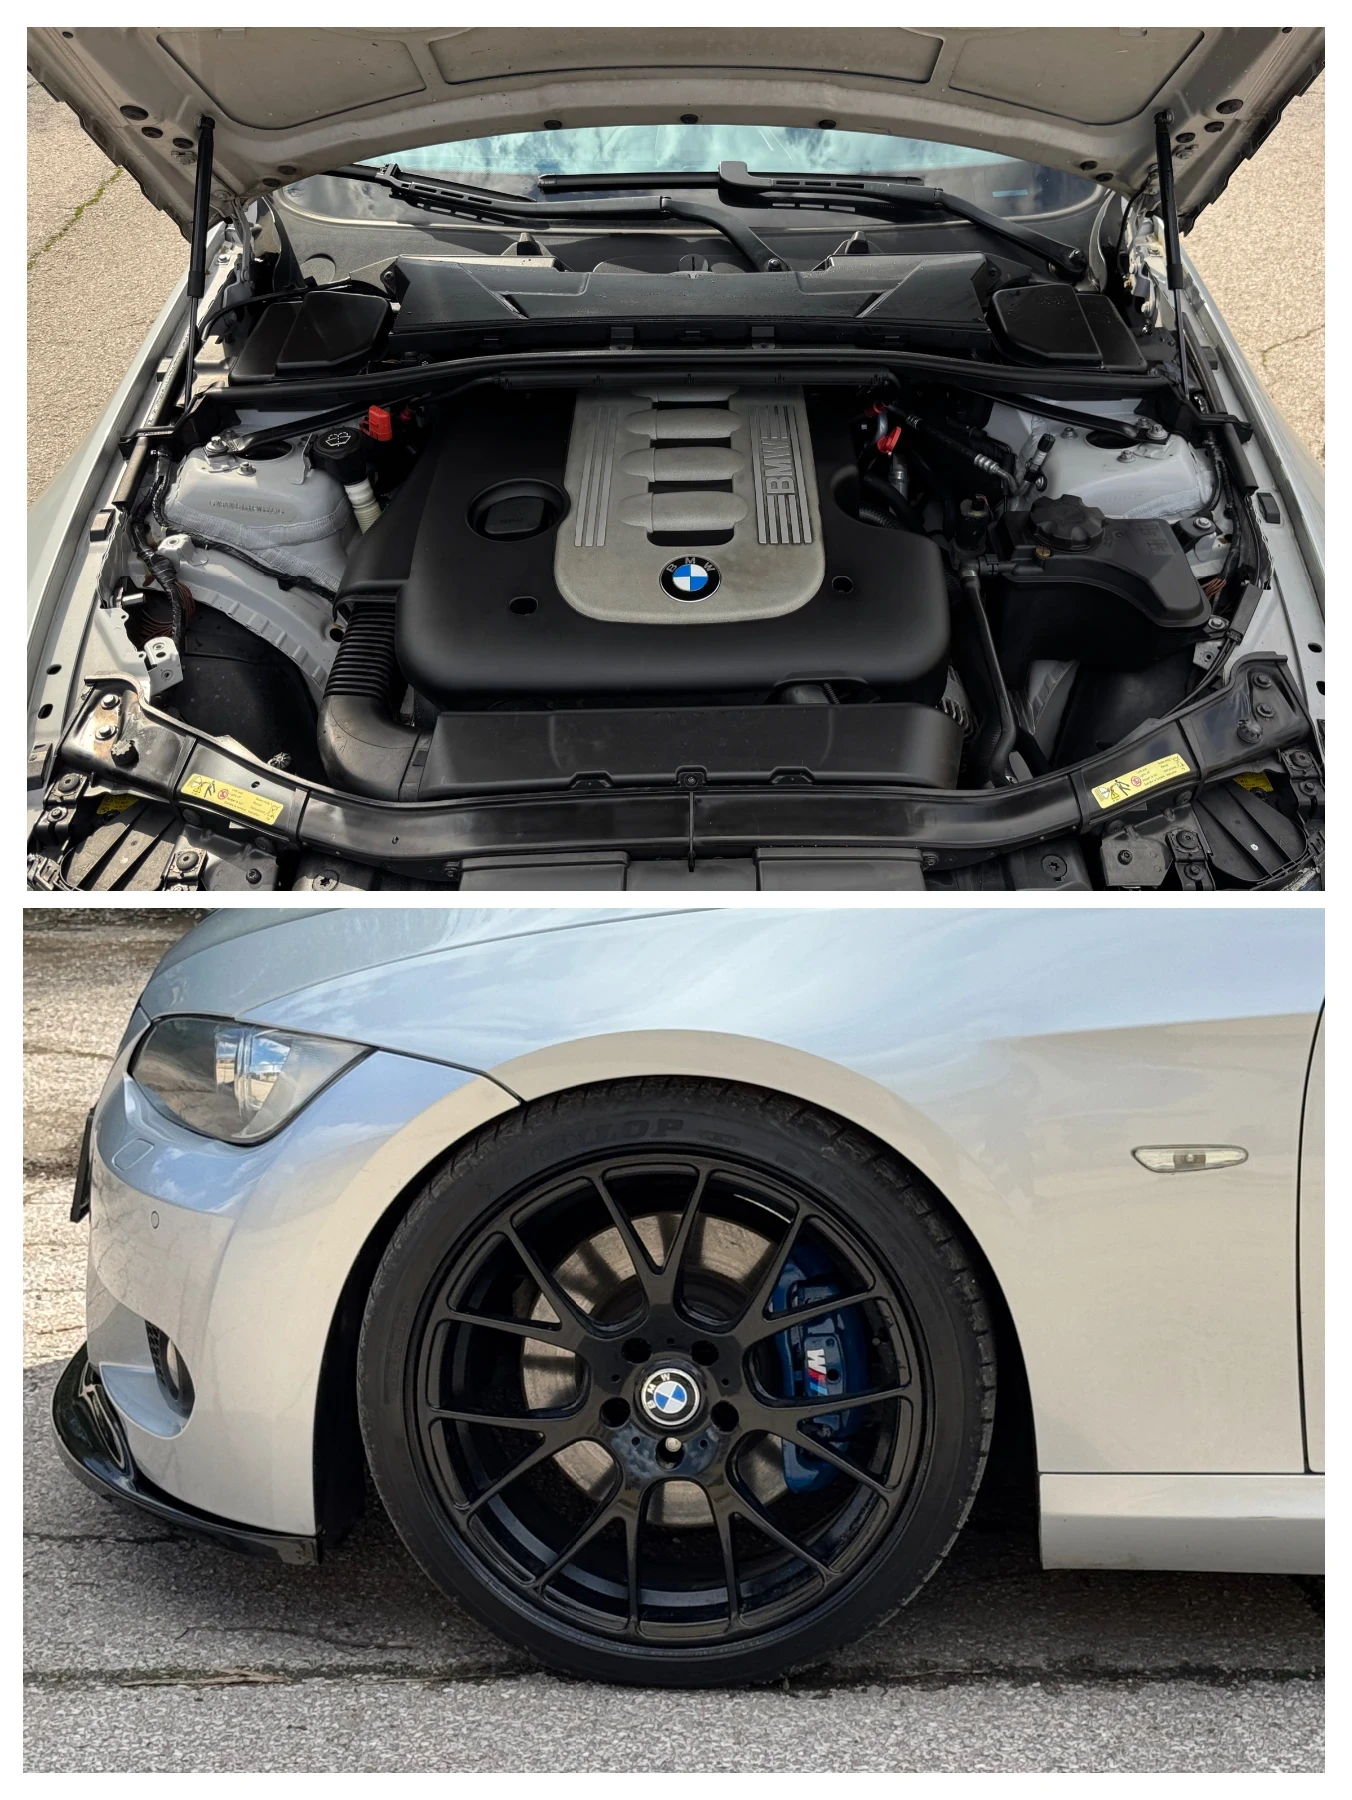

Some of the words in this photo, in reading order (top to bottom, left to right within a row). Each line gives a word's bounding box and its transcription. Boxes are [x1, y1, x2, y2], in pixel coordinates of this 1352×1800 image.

[761, 439, 796, 494] BMW
[666, 557, 716, 573] BMW
[646, 1373, 671, 1410] BMW
